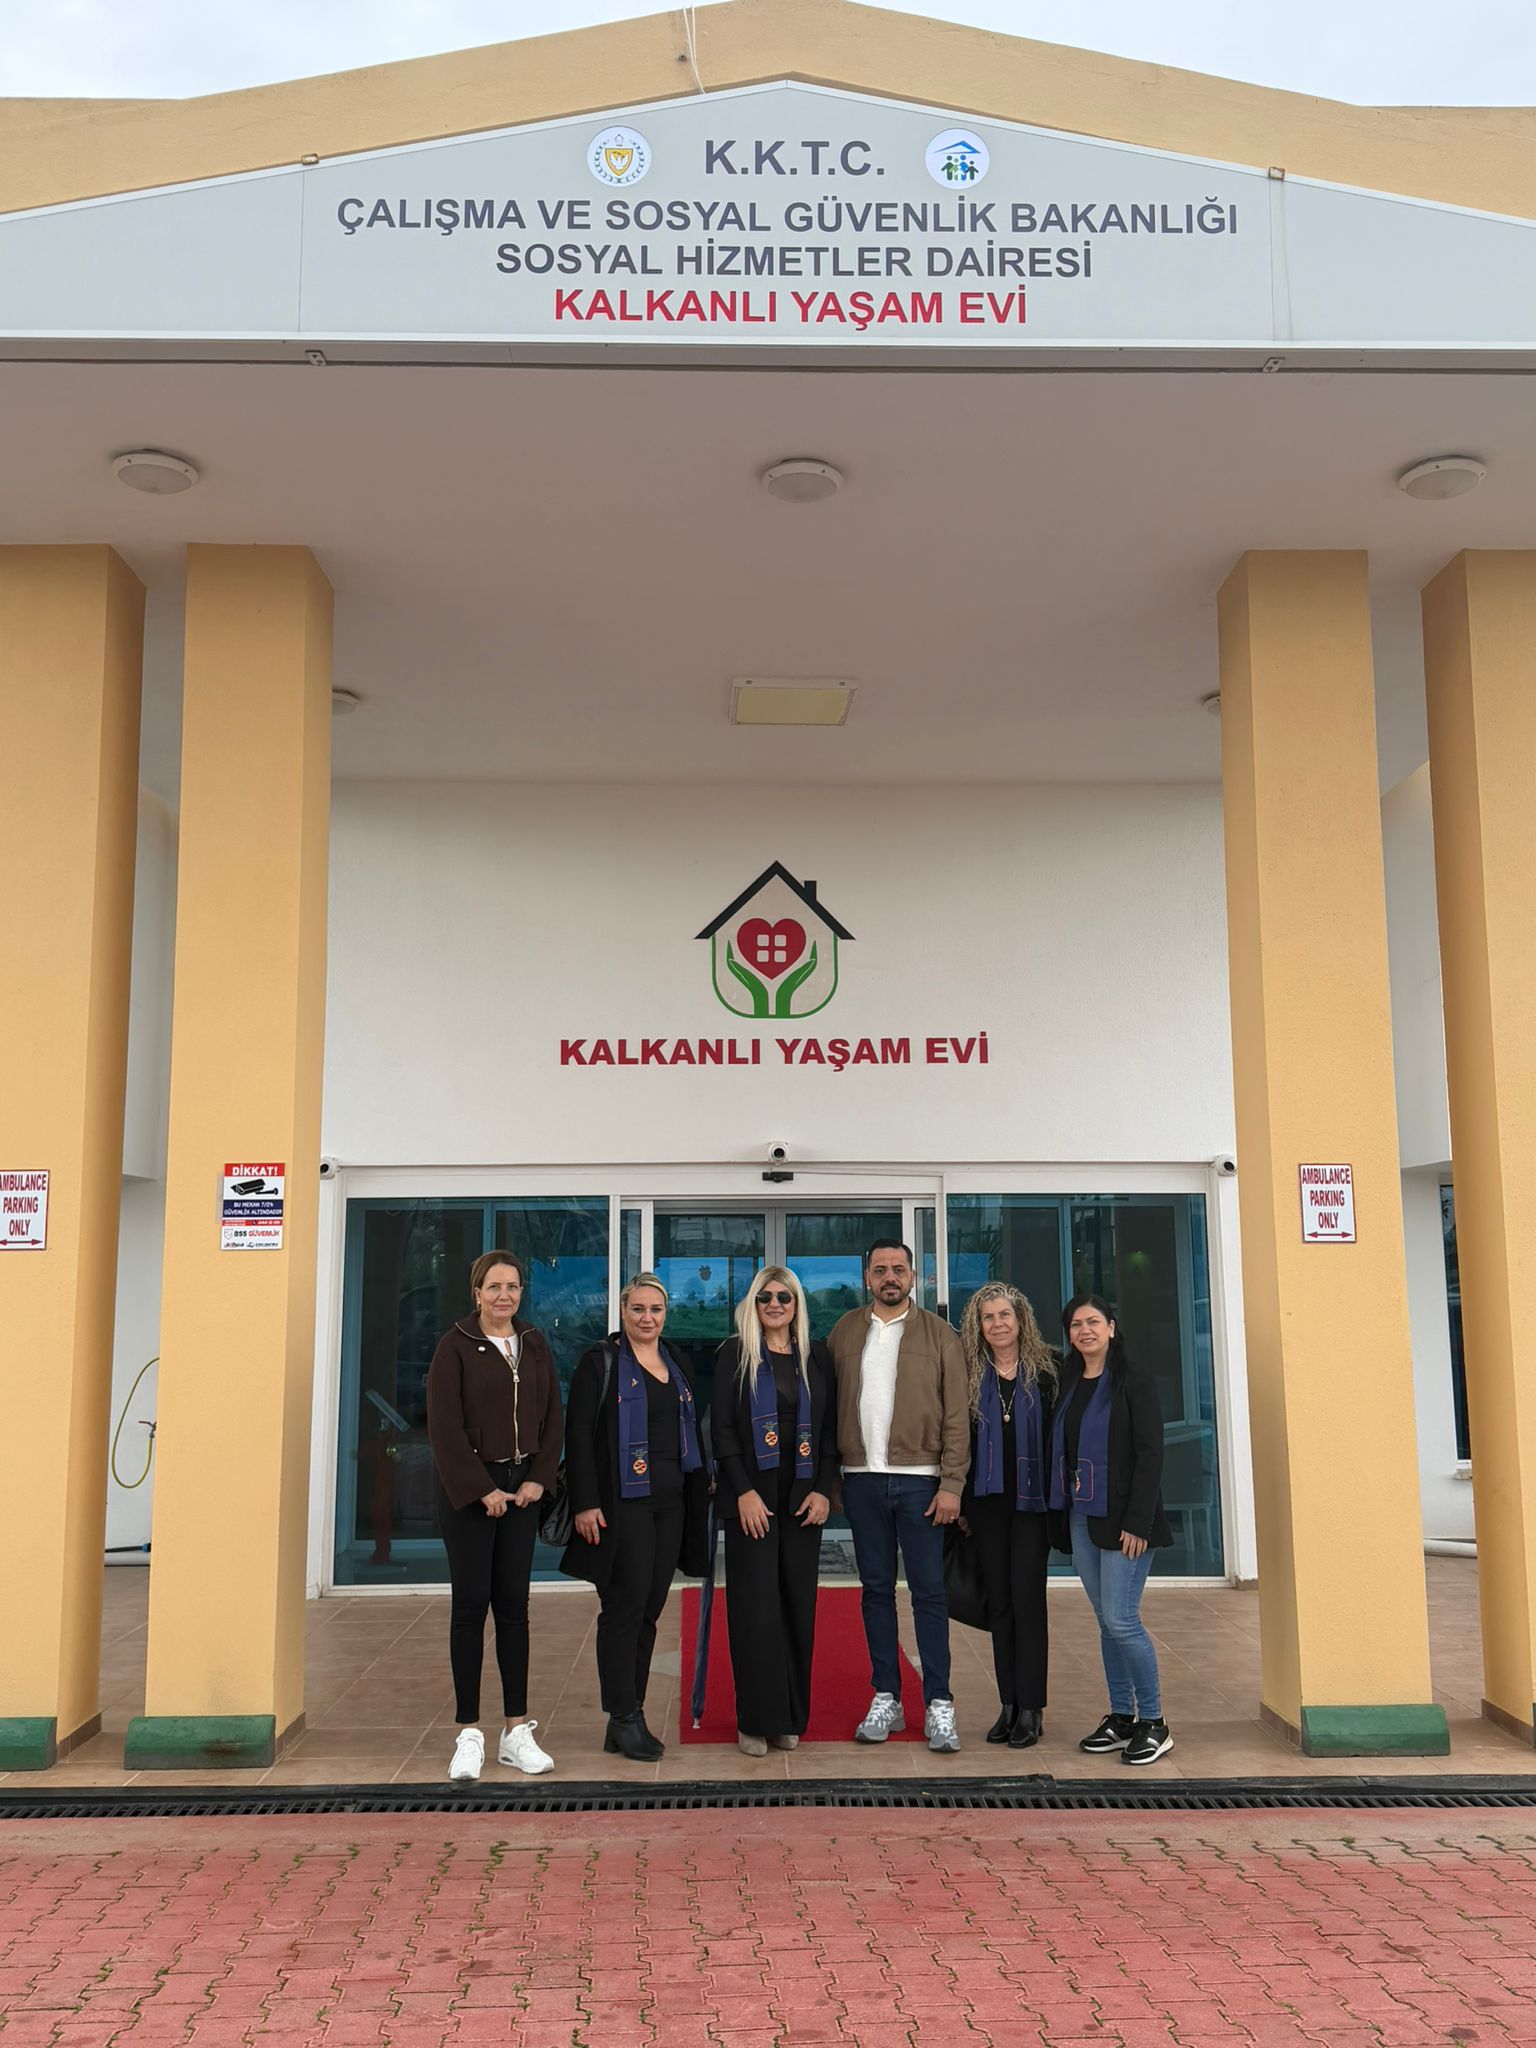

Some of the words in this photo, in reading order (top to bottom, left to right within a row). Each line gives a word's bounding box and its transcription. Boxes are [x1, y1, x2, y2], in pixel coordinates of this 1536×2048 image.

[705, 139, 885, 176] K.K.T.C.
[337, 198, 527, 236] ÇALIŞMA
[538, 200, 591, 230] VE
[605, 200, 772, 232] SOSYAL
[784, 195, 997, 233] GÜVENLİK
[1011, 196, 1238, 235] BAKANLIĞI
[496, 243, 663, 275] SOSYAL
[677, 237, 913, 277] HİZMETLER
[927, 239, 1092, 278] DAİRESİ
[555, 288, 777, 322] KALKANLI
[790, 290, 943, 331] YAŞAM
[960, 284, 1026, 324] EVİ
[560, 1039, 761, 1067] KALKANLI
[775, 1037, 910, 1072] YAŞAM
[926, 1031, 989, 1064] EVİ
[232, 1164, 278, 1176] DİKKAT!
[1302, 1168, 1350, 1184] AMBULANCE
[3, 1197, 38, 1213] PARKING
[1310, 1190, 1345, 1206] PARKING
[9, 1219, 31, 1236] ONLY
[1318, 1212, 1339, 1229] ONLY
